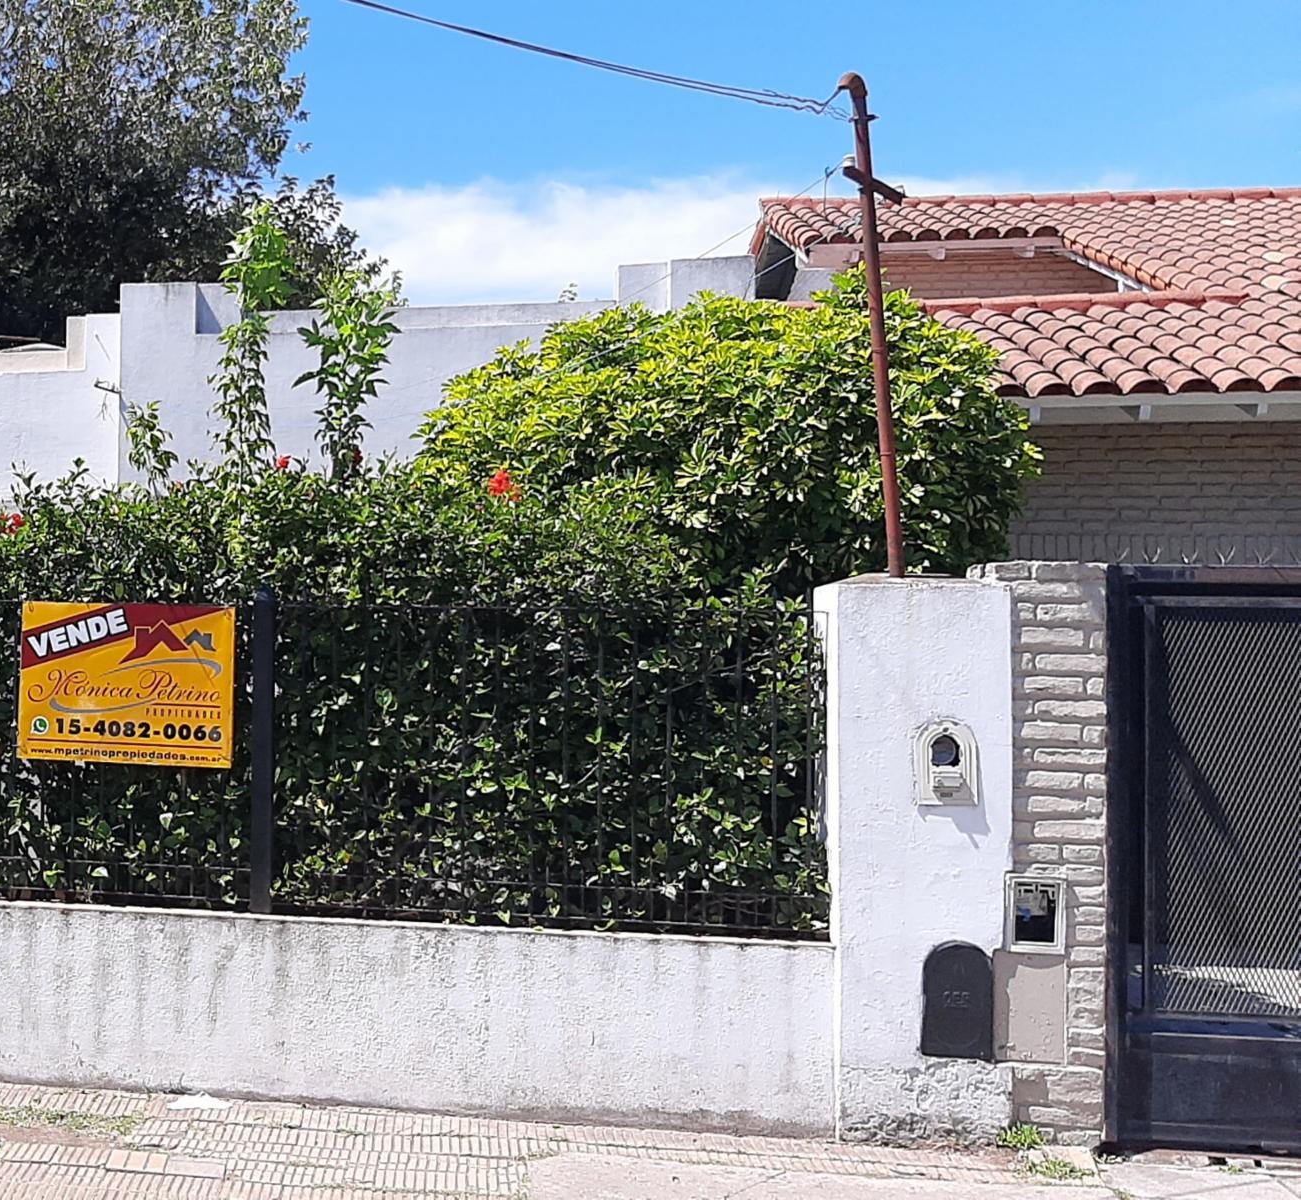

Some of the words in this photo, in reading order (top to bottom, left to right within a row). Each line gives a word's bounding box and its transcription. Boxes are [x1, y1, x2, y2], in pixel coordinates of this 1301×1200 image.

[27, 608, 129, 658] VENDE
[28, 669, 133, 703] Mónica
[136, 669, 221, 702] Petrino
[145, 707, 221, 720] PROPIEDADES
[55, 718, 223, 742] 15-4082-0066
